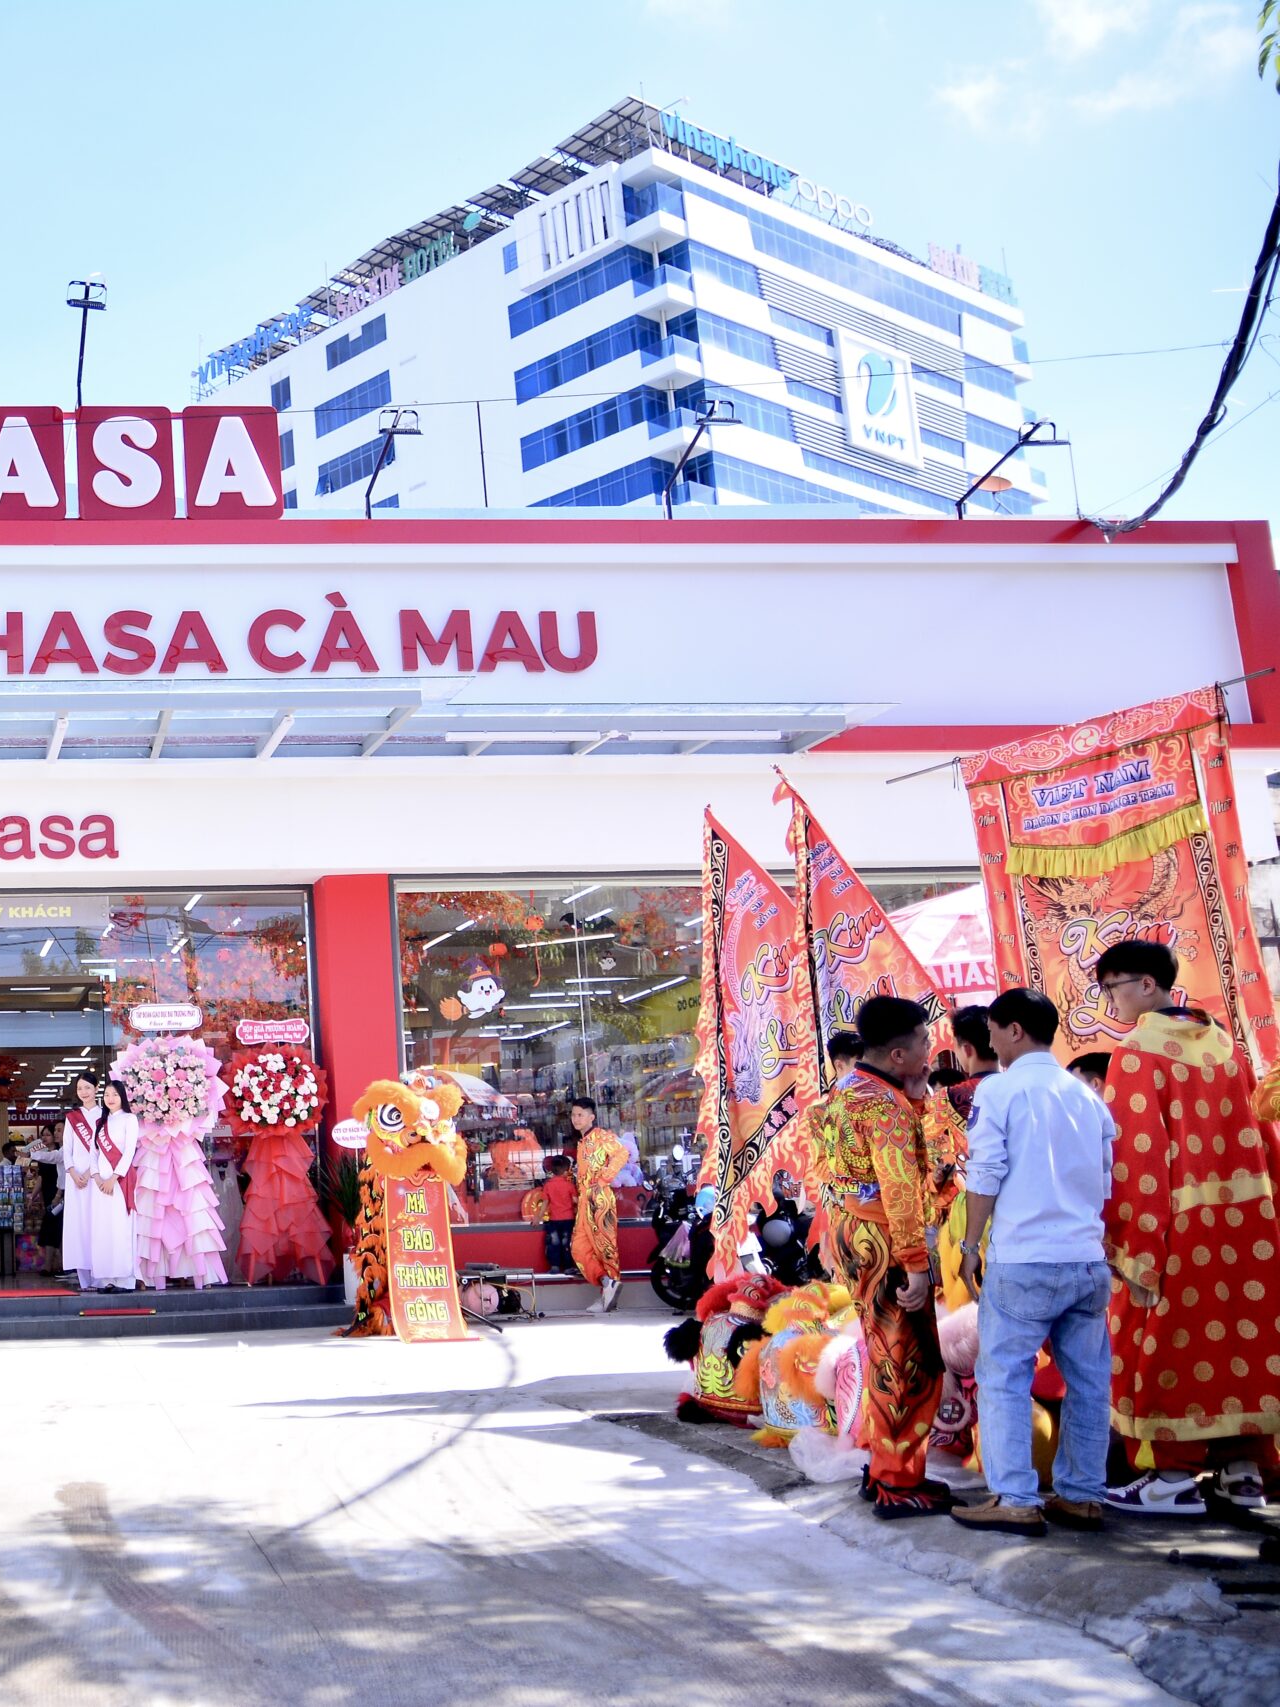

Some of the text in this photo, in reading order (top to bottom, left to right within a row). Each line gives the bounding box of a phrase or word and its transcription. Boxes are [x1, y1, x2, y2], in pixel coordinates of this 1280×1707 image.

[659, 110, 792, 191] vinaphone
[198, 303, 313, 385] vinaphone
[862, 424, 905, 450] VNPT
[247, 591, 380, 673] CÀ
[398, 609, 598, 674] MAU
[1096, 759, 1152, 794] NAM
[1100, 794, 1138, 816] DANCE
[1139, 782, 1176, 804] TEAM
[8, 904, 71, 918] KHÁCH
[402, 1225, 434, 1251] ĐÁO
[395, 1261, 449, 1288] THÀNH
[406, 1298, 449, 1323] CÔNG
